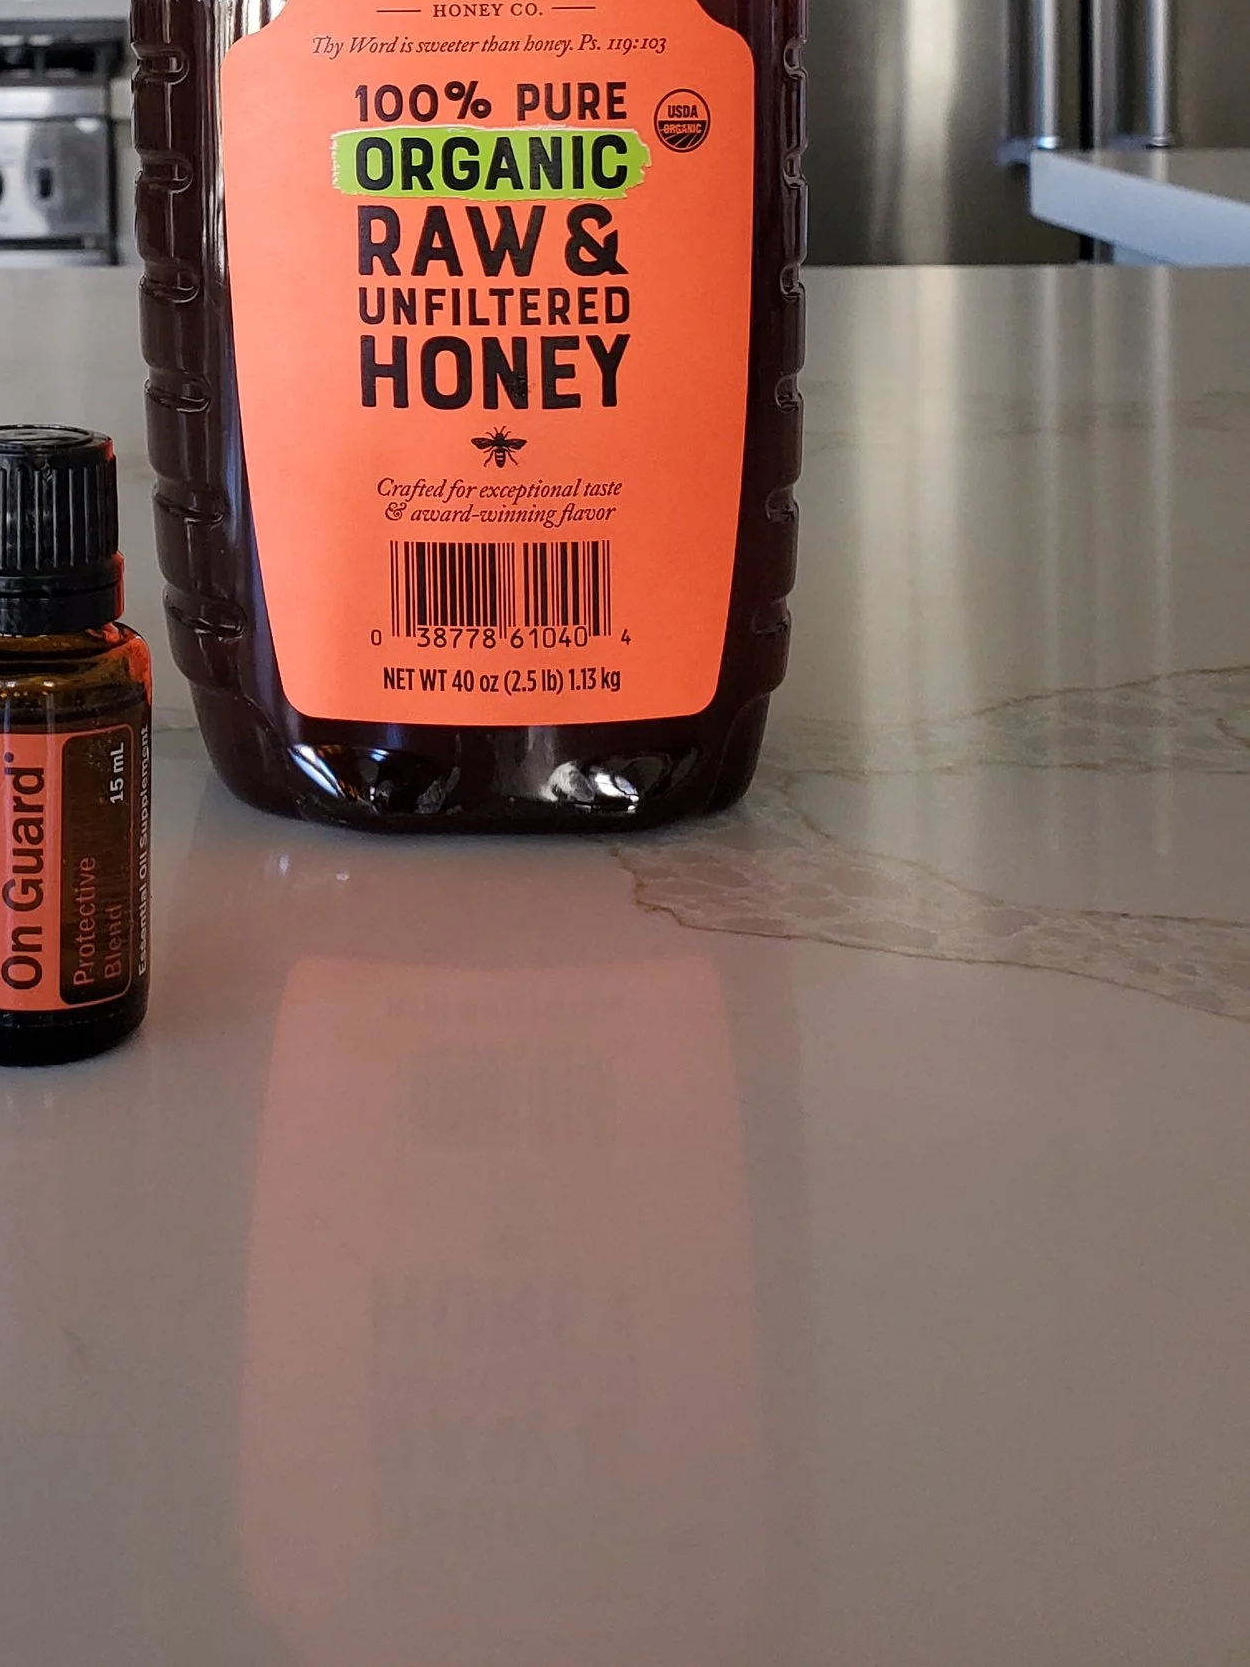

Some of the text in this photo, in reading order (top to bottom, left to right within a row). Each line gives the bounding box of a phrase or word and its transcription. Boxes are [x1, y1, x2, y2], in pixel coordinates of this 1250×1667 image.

[432, 2, 544, 18] HONEY CO.
[312, 34, 668, 60] Thy Word is sweeter than honey. Ps. 119:103
[355, 80, 628, 123] 100% PURE
[667, 105, 699, 119] USDA
[663, 123, 702, 134] ORGANIC
[355, 134, 628, 191] ORGANIC
[357, 202, 629, 278] RAW &
[358, 285, 630, 326] UNFILTERED
[360, 333, 631, 411] HONEY
[376, 477, 623, 505] Crafted for exceptional taste
[384, 501, 617, 529] & award-winning flavor
[370, 626, 632, 649] 0 38778 61040 4
[383, 666, 621, 696] NET WT 40 oz (2.5 lb) 1.13 kg
[110, 741, 124, 805] 15 mL
[138, 725, 149, 977] Essential Oil Supplement
[73, 856, 96, 987] Protective
[104, 904, 124, 979] Blend
[1, 925, 44, 991] On
